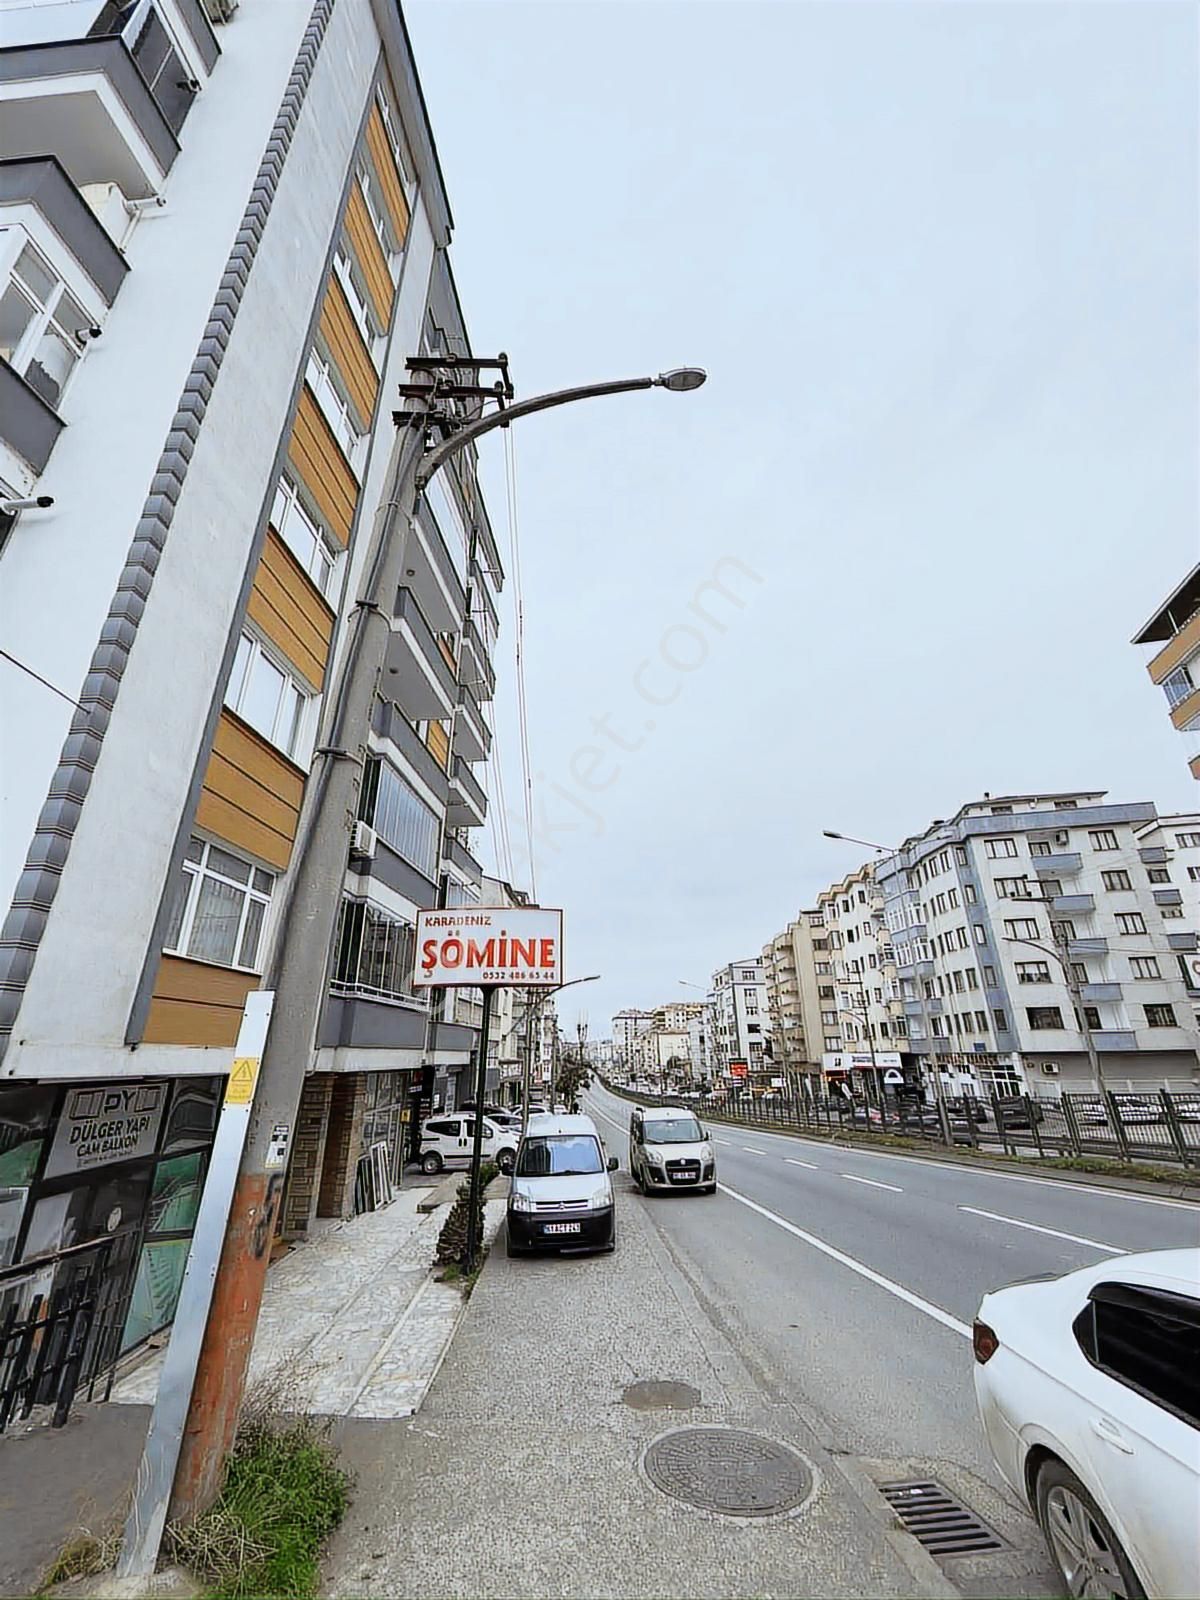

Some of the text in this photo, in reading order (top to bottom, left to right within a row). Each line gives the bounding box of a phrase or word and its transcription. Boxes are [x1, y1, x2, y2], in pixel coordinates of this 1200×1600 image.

[425, 915, 492, 927] KARADENİZ
[421, 930, 556, 978] ŞÖMİNE
[482, 971, 505, 980] 0532
[543, 971, 554, 980] 44
[69, 1116, 151, 1144] DÜLGER YAPI
